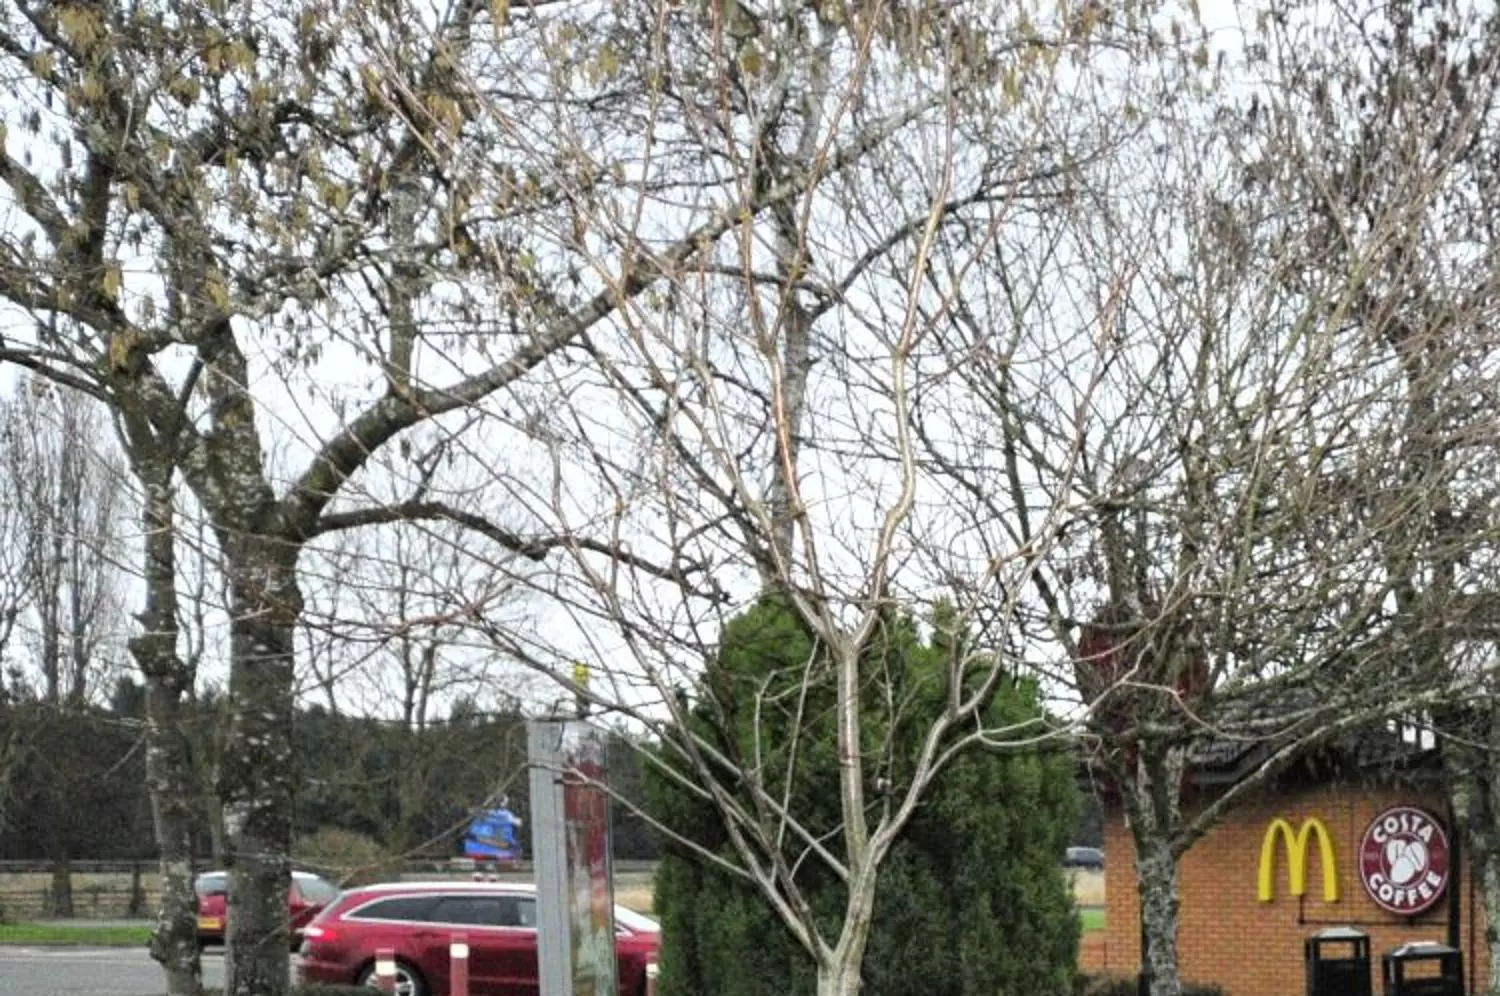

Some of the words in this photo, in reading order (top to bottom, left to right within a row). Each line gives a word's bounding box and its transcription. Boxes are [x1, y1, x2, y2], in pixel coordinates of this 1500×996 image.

[1373, 814, 1433, 843] COSTA
[1257, 817, 1338, 902] M
[1370, 872, 1441, 906] COFFEE
